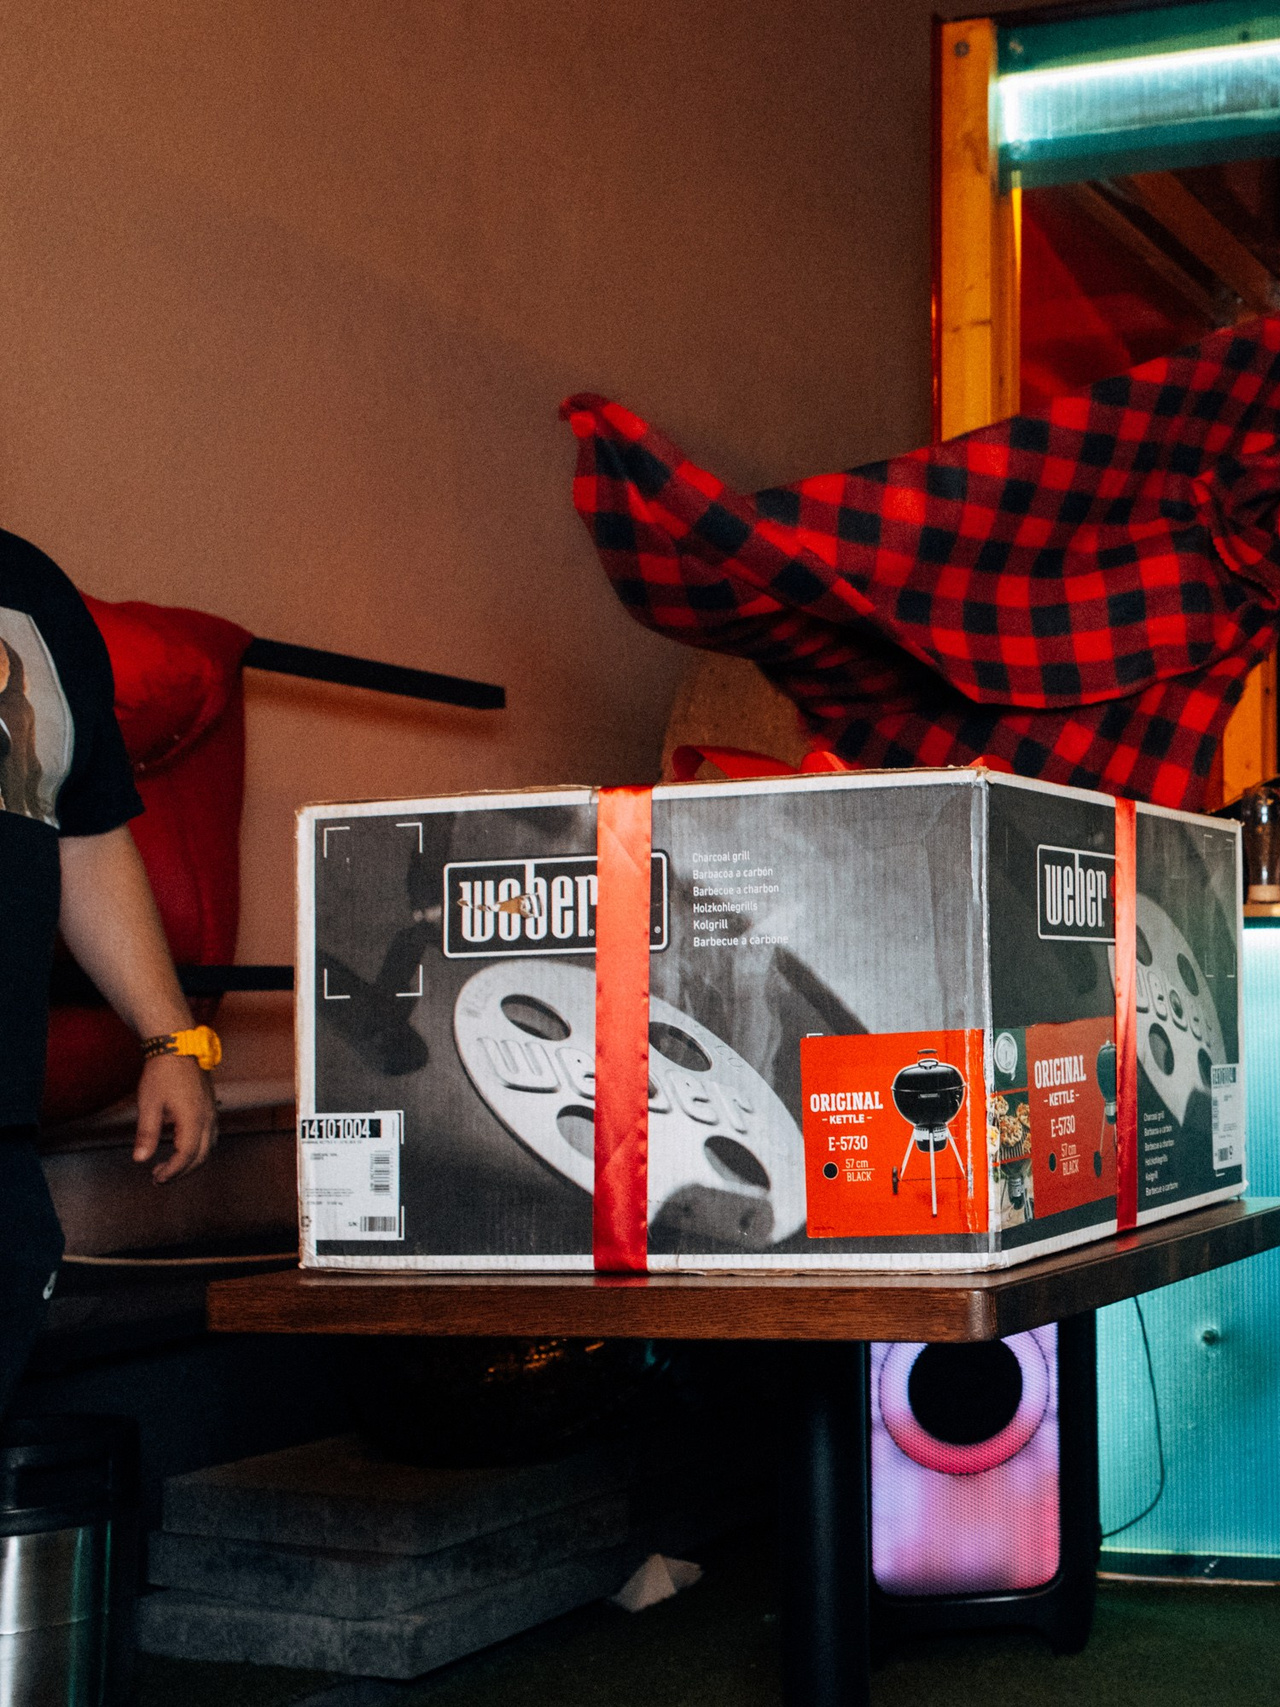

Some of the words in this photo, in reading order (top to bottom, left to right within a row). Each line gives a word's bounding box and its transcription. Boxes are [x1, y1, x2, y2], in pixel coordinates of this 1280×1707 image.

[692, 851, 730, 863] Charcoal
[732, 850, 750, 863] grill
[692, 869, 734, 880] Barbacoa
[735, 869, 741, 877] a
[743, 866, 774, 877] carbón
[693, 886, 734, 897] Barbecue
[736, 886, 741, 894] a
[743, 883, 780, 894] charbon
[1044, 853, 1107, 929] weber
[459, 862, 598, 943] weber
[693, 901, 758, 914] Holzkohlegrills
[693, 918, 728, 932] Kolgrill
[693, 936, 739, 947] Barbecue
[741, 937, 747, 945] a
[749, 934, 789, 945] carbone
[1034, 1055, 1087, 1089] ORIGINAL
[809, 1090, 884, 1113] ORIGINAL
[1048, 1089, 1075, 1107] KETTLE
[829, 1114, 865, 1125] KETTLE
[1050, 1115, 1076, 1138] E-5730
[302, 1120, 371, 1139] 14101004
[827, 1135, 868, 1152] E-5730
[1061, 1142, 1068, 1157] 57
[1068, 1144, 1077, 1156] cm
[845, 1158, 855, 1169] 57
[856, 1159, 869, 1168] cm
[1062, 1159, 1079, 1176] BLACK
[846, 1171, 872, 1182] BLACK
